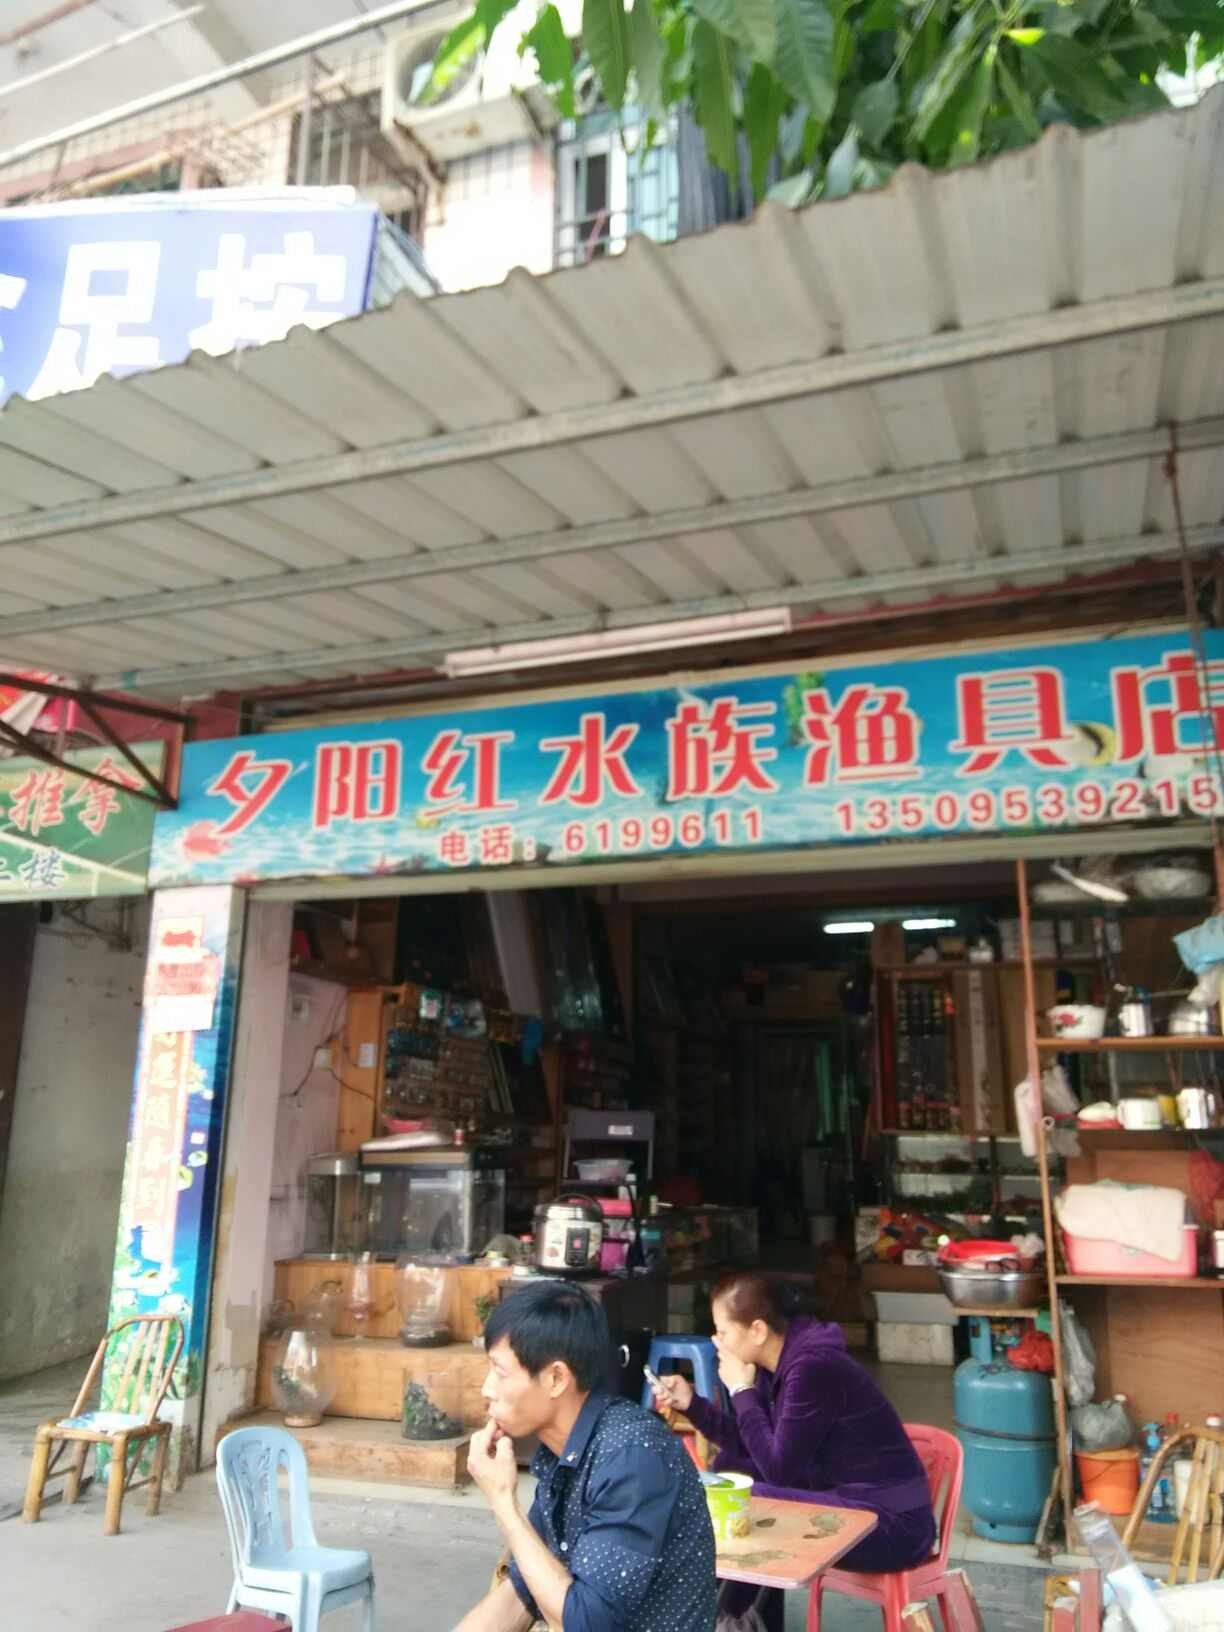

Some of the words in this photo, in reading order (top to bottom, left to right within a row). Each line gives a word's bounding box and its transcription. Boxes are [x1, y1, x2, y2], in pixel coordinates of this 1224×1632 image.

[0, 231, 348, 402] 足按
[205, 652, 1224, 838] 夕阳红水族渔具店
[836, 775, 1220, 834] 13509539215
